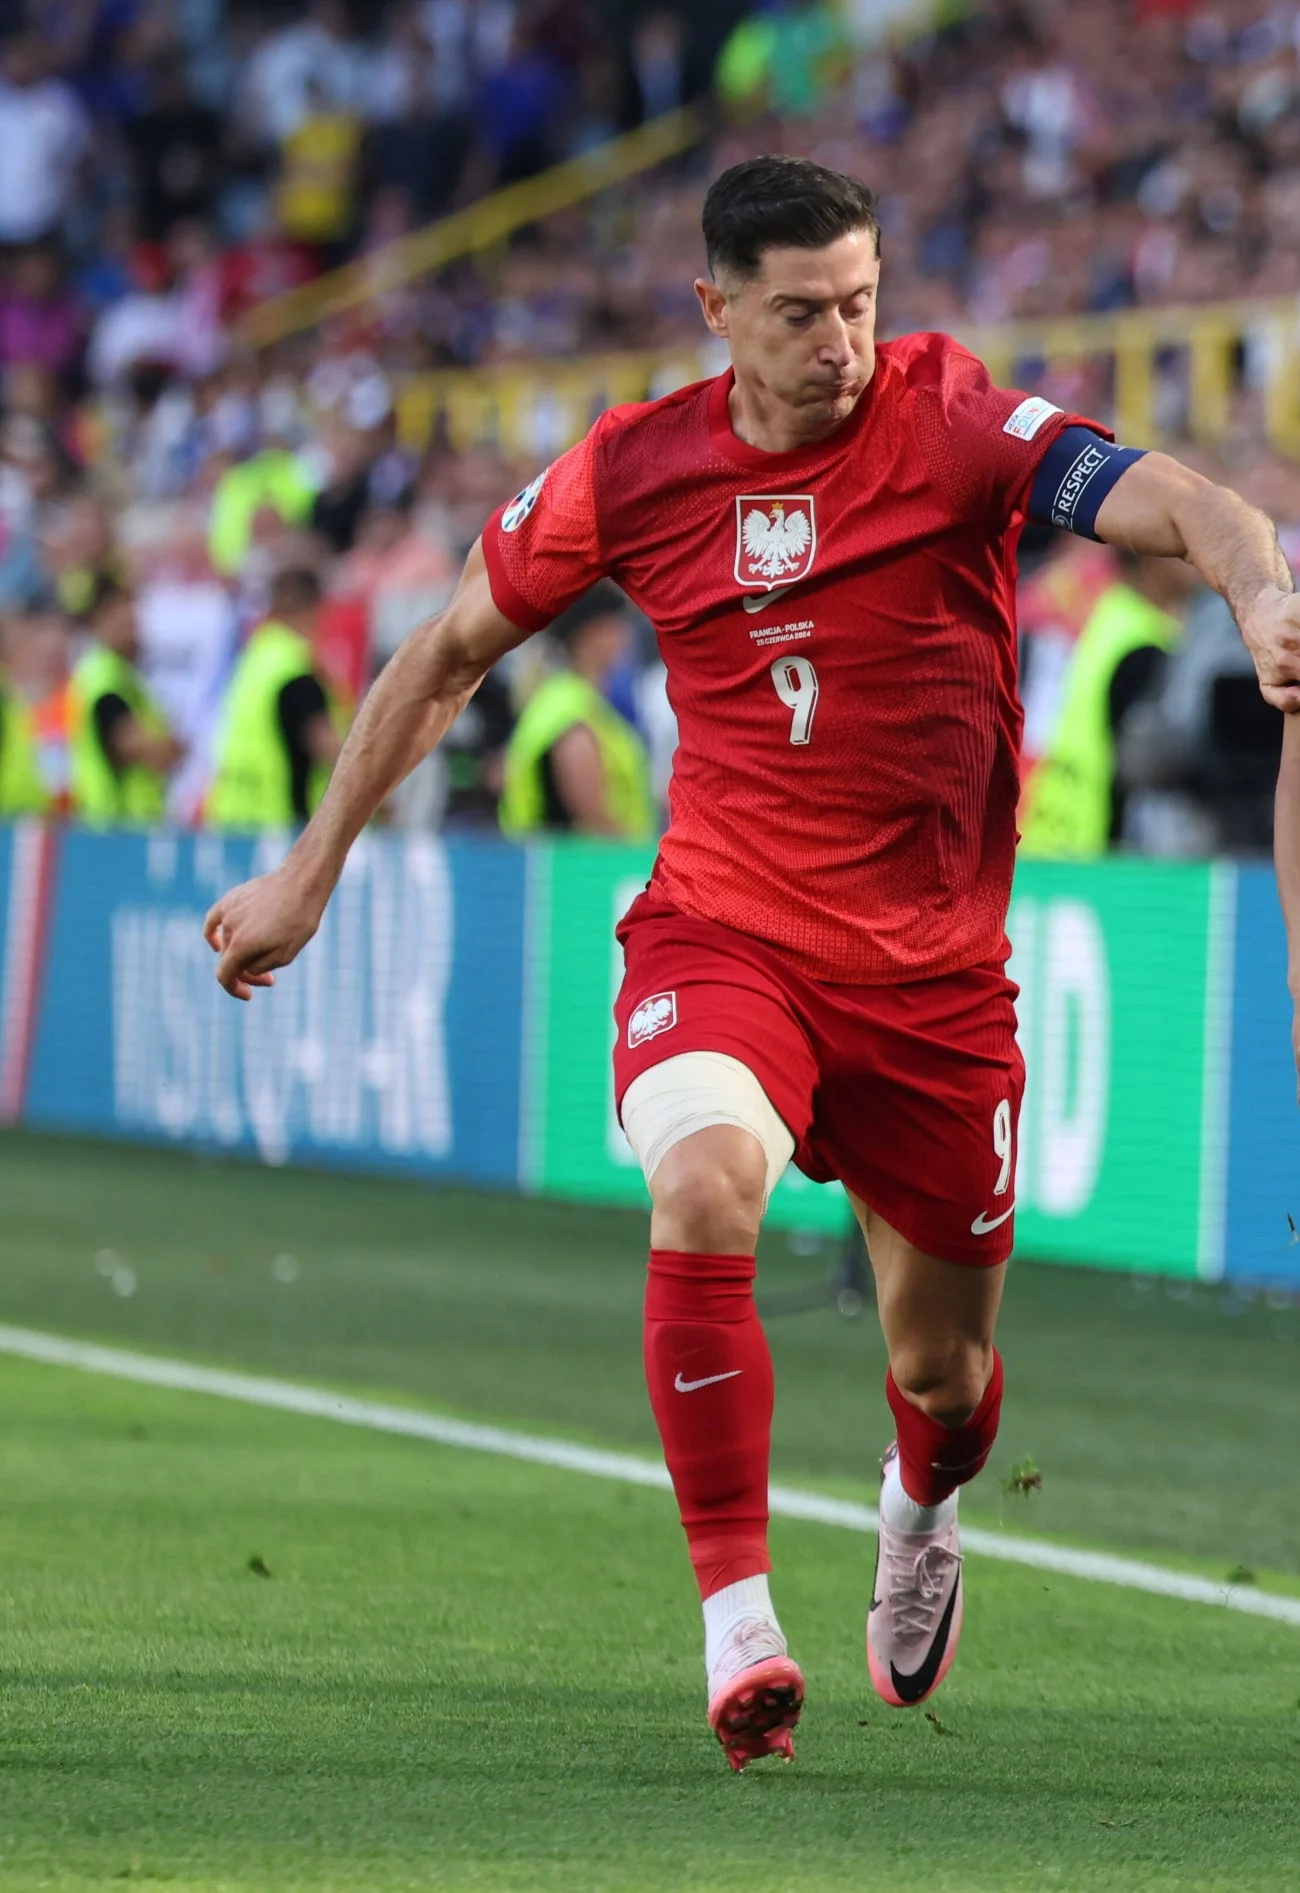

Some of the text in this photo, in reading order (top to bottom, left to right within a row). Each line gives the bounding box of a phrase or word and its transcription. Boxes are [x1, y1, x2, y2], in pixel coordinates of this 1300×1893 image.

[1058, 447, 1104, 514] RESPECT
[749, 626, 782, 639] FRANCJA
[784, 620, 815, 632] POLSKA
[765, 633, 794, 645] CZERWCA
[794, 631, 811, 640] 2024
[770, 655, 819, 745] 9
[993, 1098, 1012, 1196] 9
